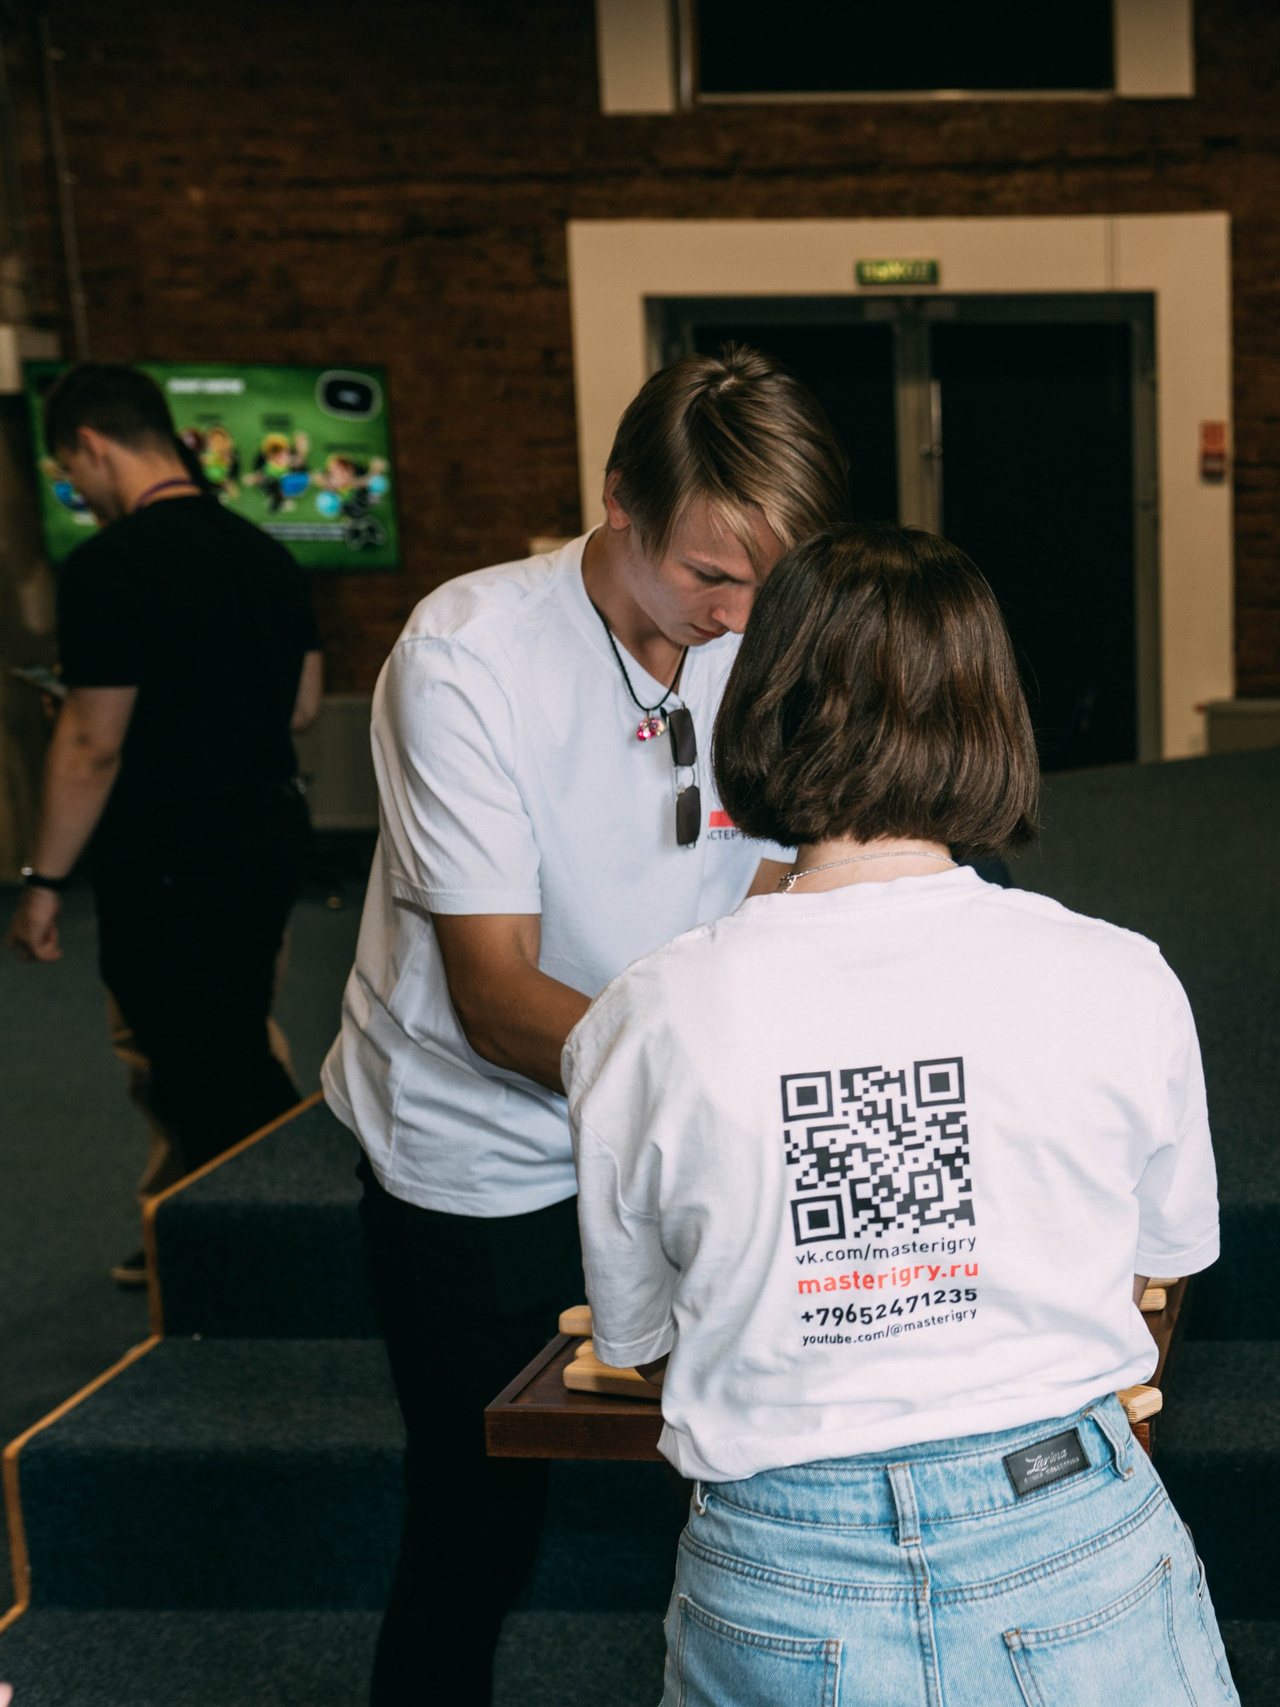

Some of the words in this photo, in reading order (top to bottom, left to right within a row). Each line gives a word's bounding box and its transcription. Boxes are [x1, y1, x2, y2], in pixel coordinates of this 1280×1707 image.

[795, 1236, 976, 1265] vk.com/masterigry
[798, 1263, 979, 1294] masterigry.ru
[801, 1288, 978, 1326] +79652471235
[802, 1307, 977, 1346] youtube.com/@masterigry
